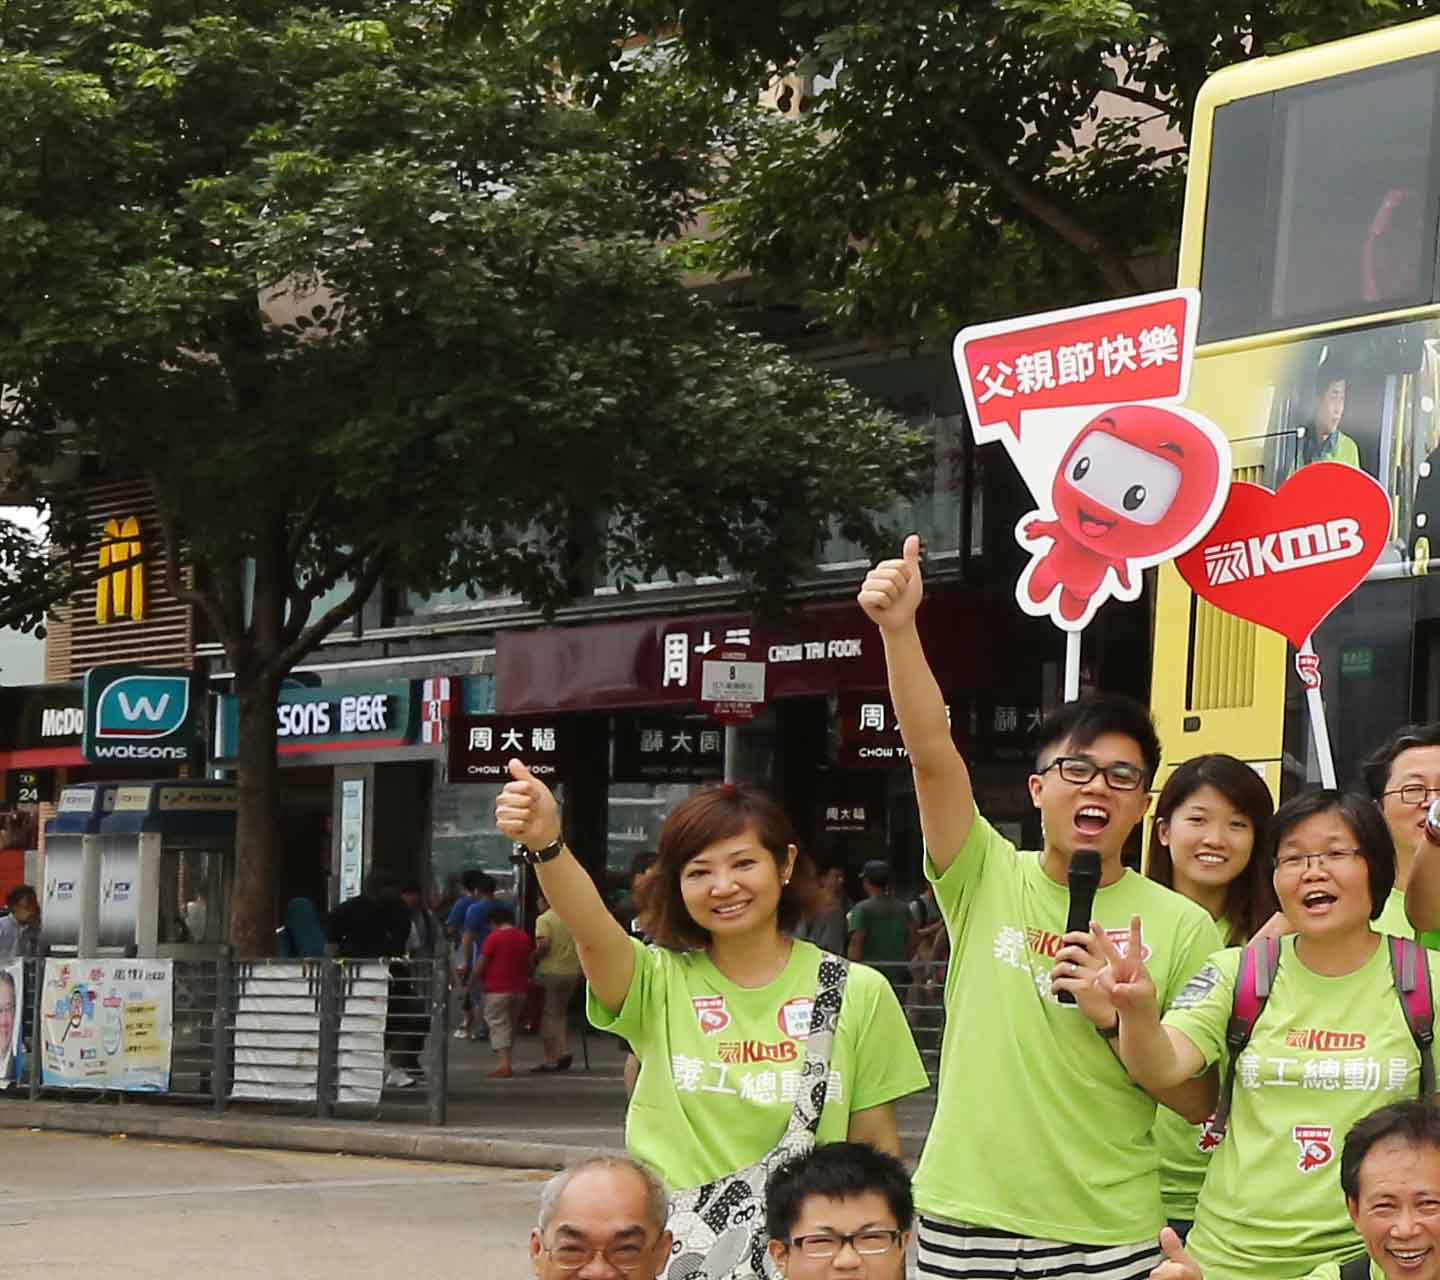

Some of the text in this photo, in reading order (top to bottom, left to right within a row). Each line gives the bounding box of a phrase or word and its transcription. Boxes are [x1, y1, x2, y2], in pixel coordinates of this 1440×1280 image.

[976, 325, 1179, 404] 父親節快樂
[1249, 517, 1365, 577] KMB
[768, 643, 802, 664] CHOW
[827, 638, 862, 658] FOOK
[467, 725, 557, 753] 周大福
[95, 745, 187, 760] watsons
[858, 748, 893, 759] CHOW
[742, 1039, 799, 1064] KMB
[1306, 1030, 1367, 1052] KMB
